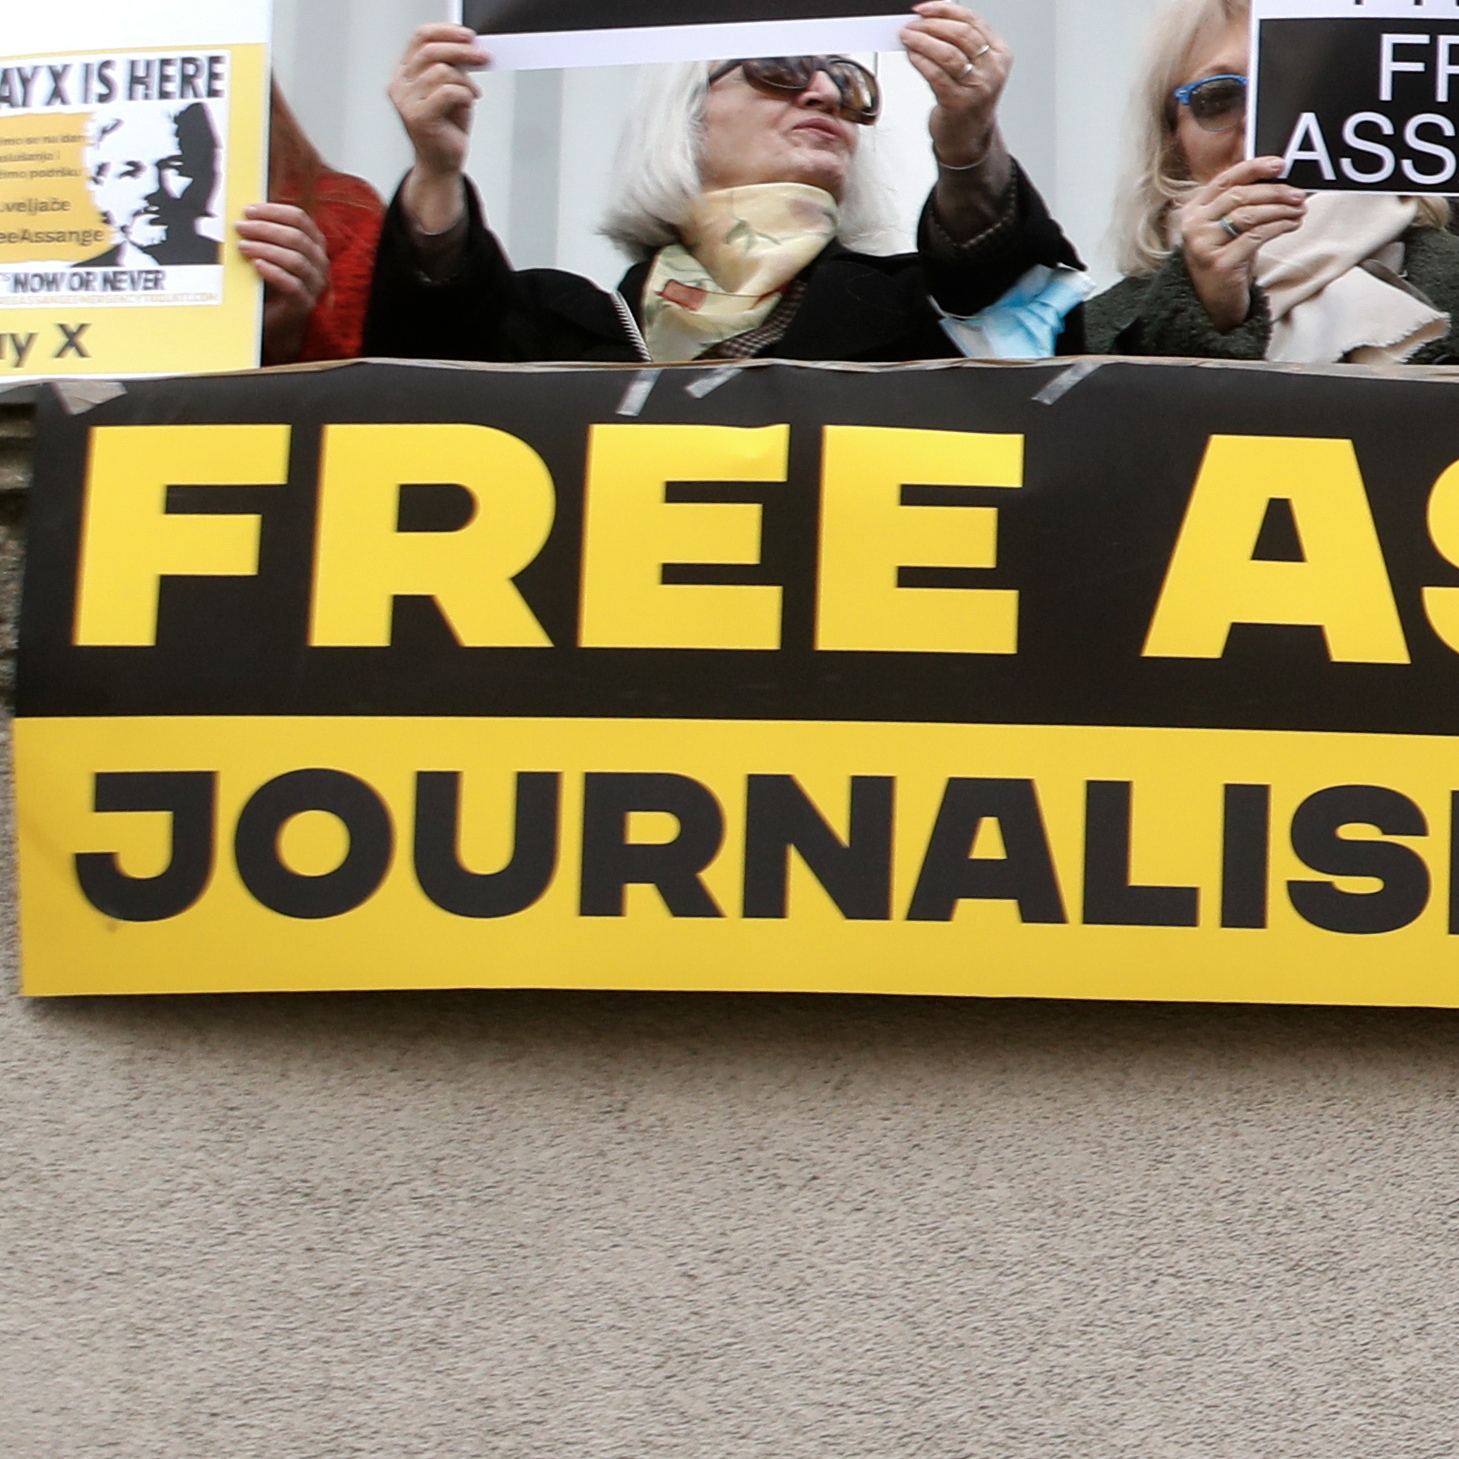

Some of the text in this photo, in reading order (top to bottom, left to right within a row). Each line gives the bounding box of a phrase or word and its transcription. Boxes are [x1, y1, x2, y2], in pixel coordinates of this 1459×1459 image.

[0, 55, 226, 108] AY X IS HERE
[0, 229, 105, 247] eeAssange
[13, 271, 65, 293] NOW
[69, 271, 98, 292] OR
[102, 270, 166, 292] NEVER
[53, 322, 93, 358] X
[72, 422, 1025, 655] FREE
